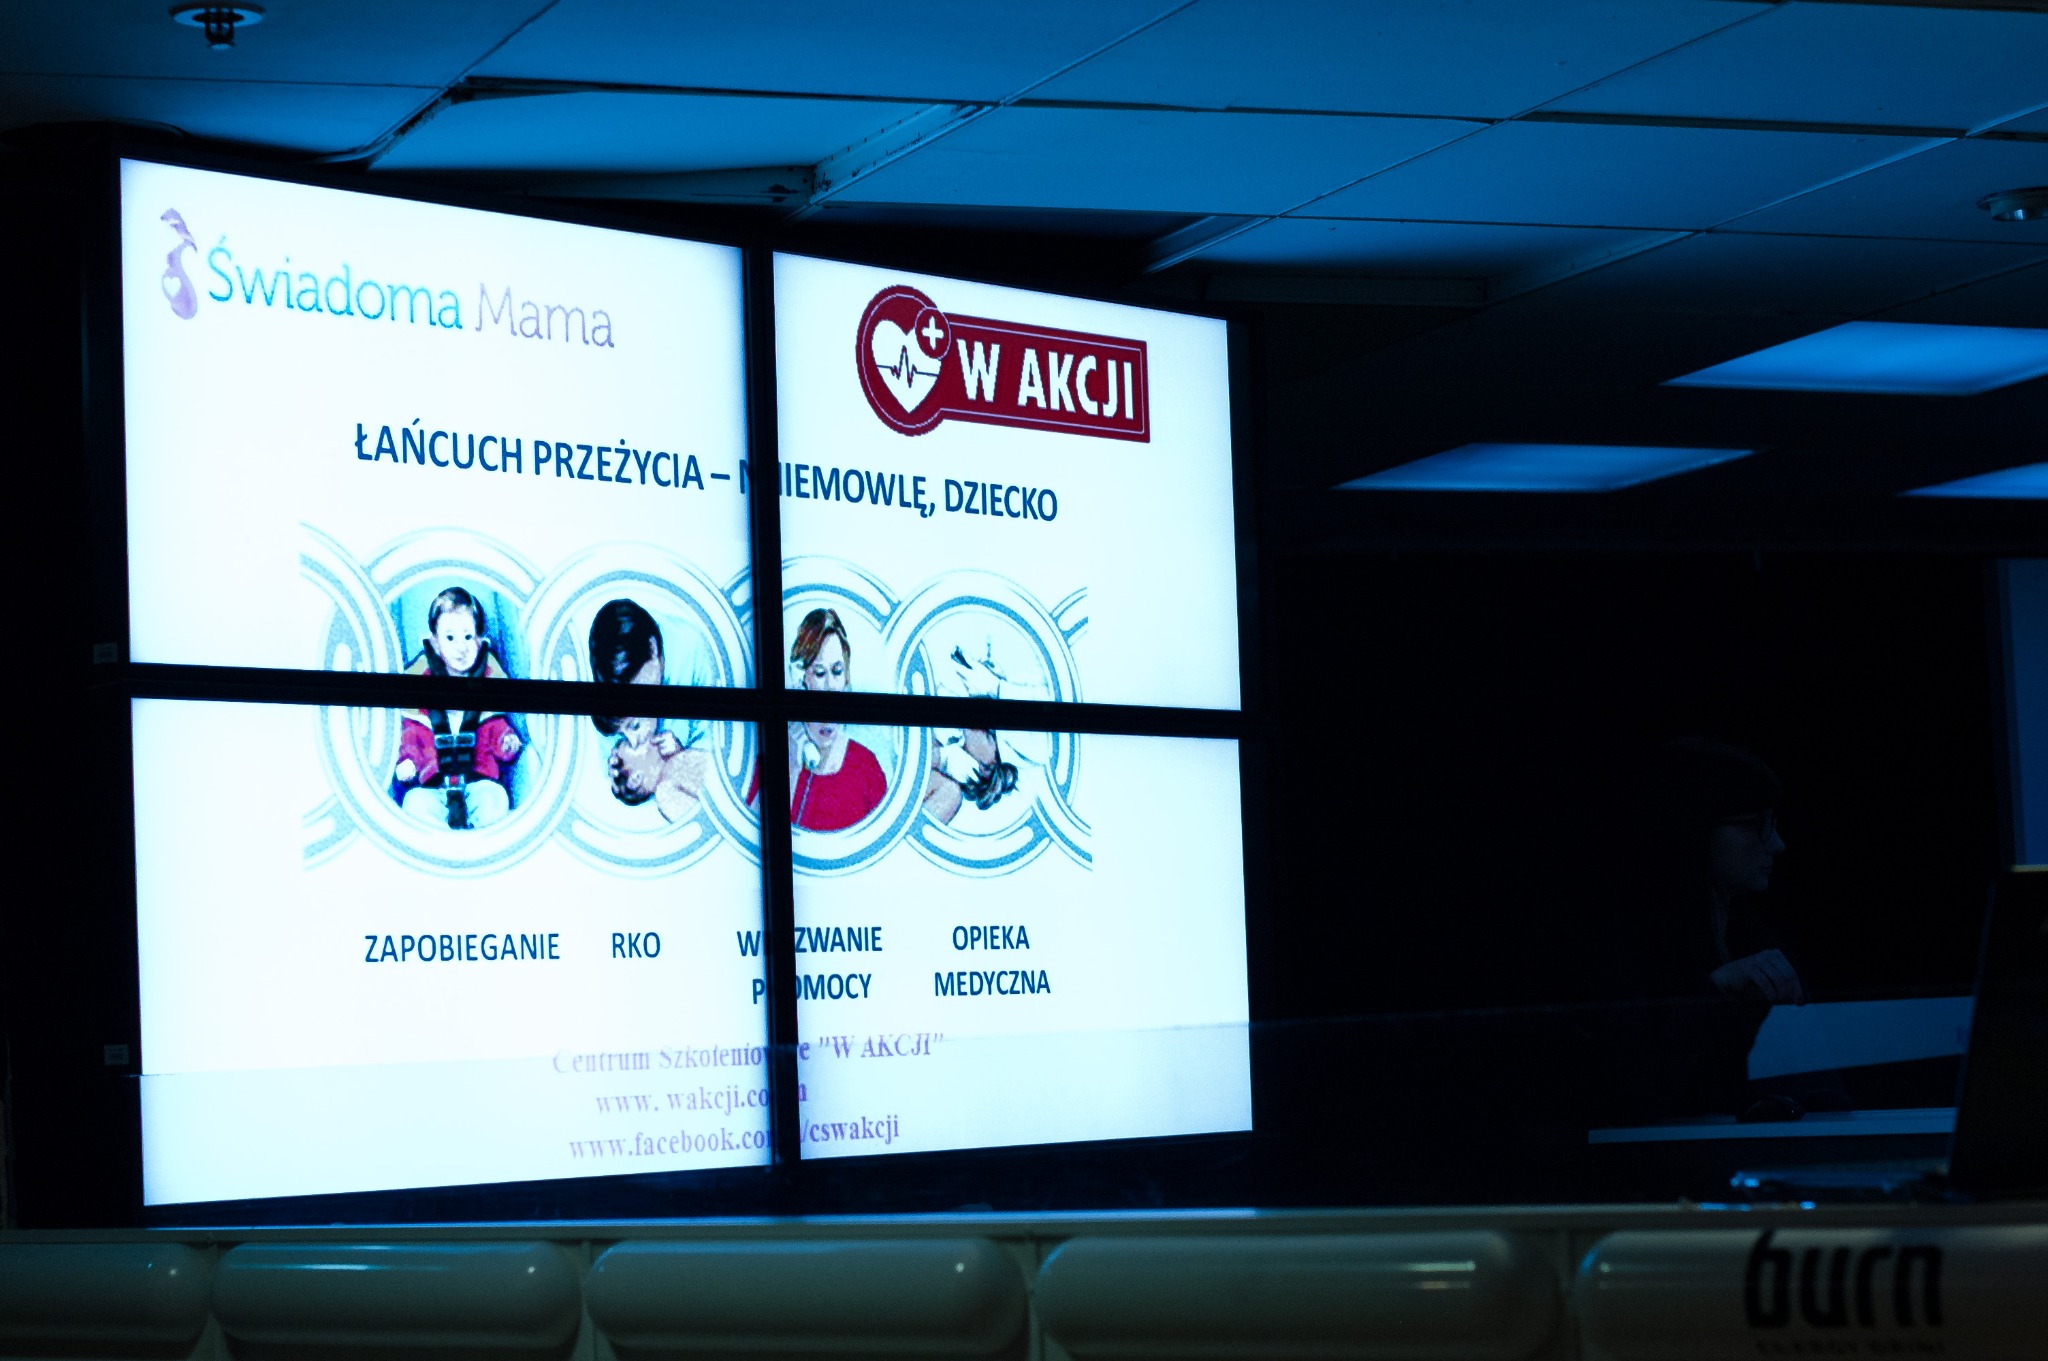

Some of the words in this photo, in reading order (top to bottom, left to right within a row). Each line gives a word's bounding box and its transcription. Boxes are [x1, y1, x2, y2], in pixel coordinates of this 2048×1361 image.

[206, 236, 463, 330] Świadoma
[475, 282, 615, 349] Mama
[957, 338, 1001, 403] W
[1018, 348, 1134, 421] AKCJI
[354, 418, 522, 474] ŁAŃCUCH
[534, 438, 704, 491] PRZEŻYCIA
[944, 479, 1059, 522] DZIECKO
[364, 933, 560, 963] ZAPOBIEGANIE
[612, 931, 661, 959] RKO
[736, 926, 883, 957] WZWANIE
[952, 925, 1030, 951] OPIEKA
[934, 970, 1051, 997] MEDYCZNA
[552, 1048, 651, 1074] Centrum
[659, 1041, 811, 1070] Szkolenioe
[568, 1114, 900, 1160] www.facebook.co/cswakcji
[1745, 1228, 1944, 1328] burn
